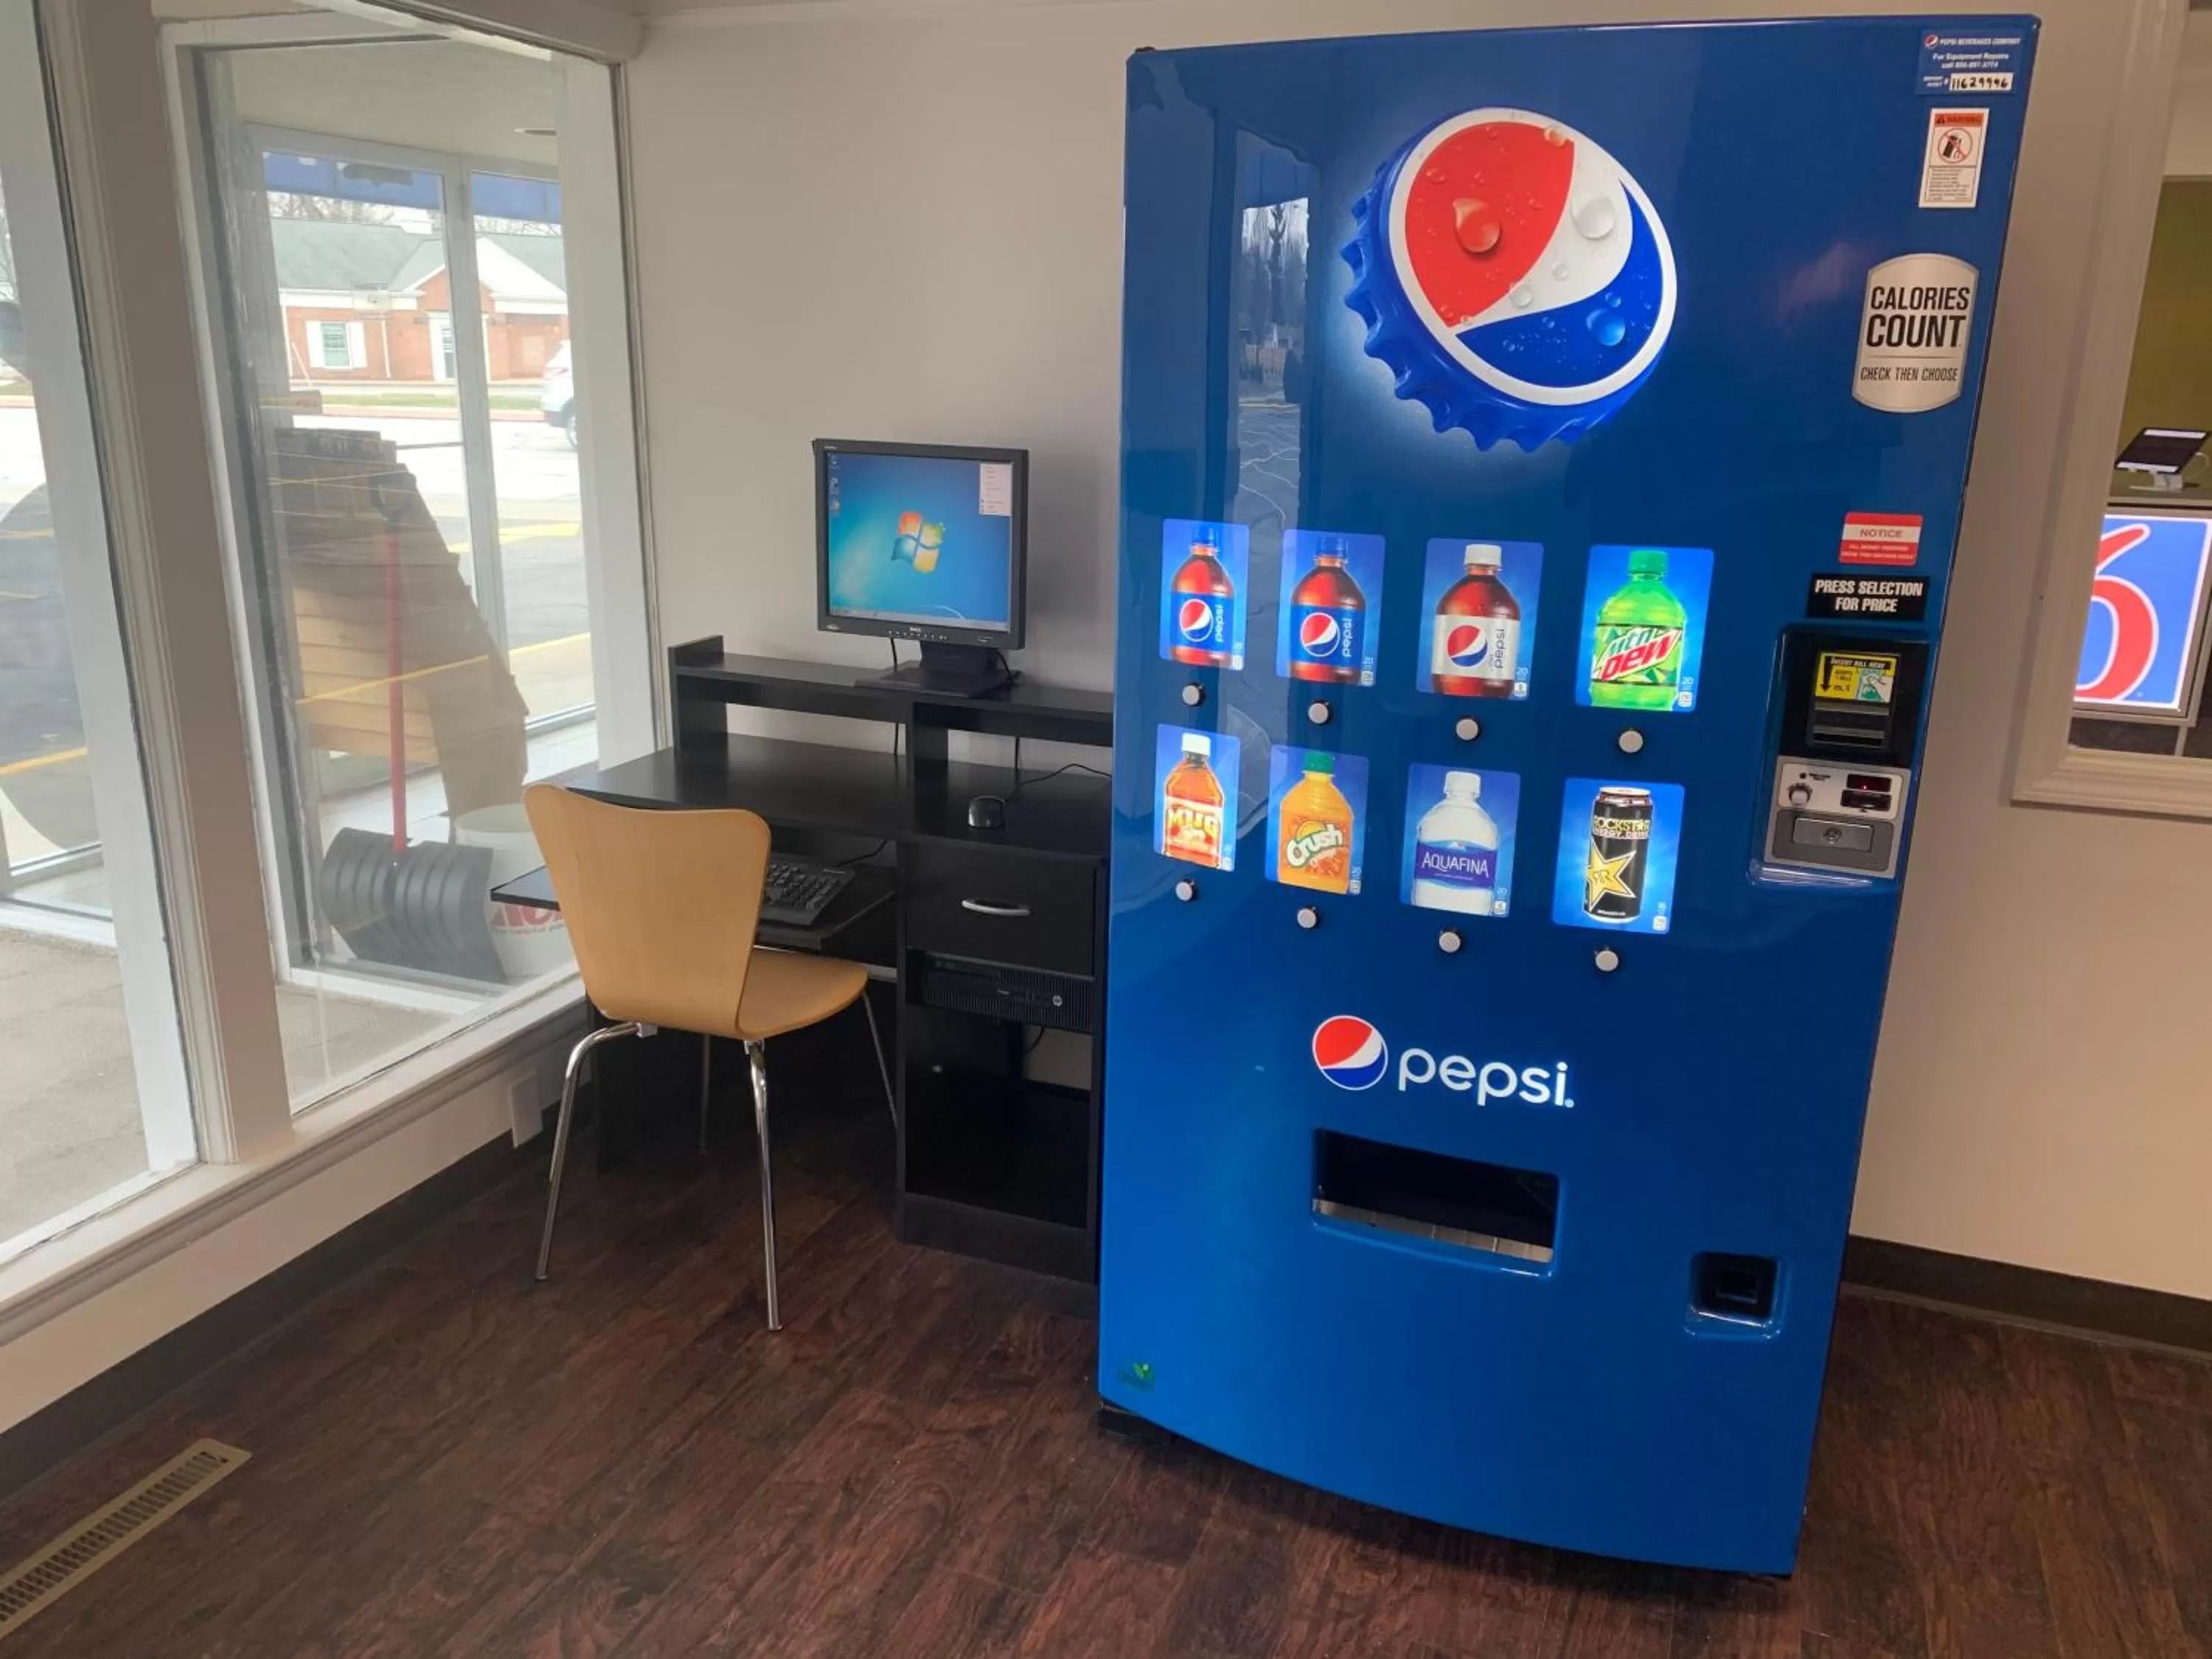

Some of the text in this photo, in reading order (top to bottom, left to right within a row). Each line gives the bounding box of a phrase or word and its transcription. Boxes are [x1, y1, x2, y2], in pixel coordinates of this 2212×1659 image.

[1871, 286, 1971, 310] CALORIES
[1865, 314, 1966, 348] COUNT
[1860, 366, 1959, 382] CHECK THEN CHOOSE
[1860, 528, 1903, 539] NOTICE
[1815, 579, 1924, 597] PRESS SELECTION
[1834, 597, 1899, 613] FOR PRICE
[1214, 603, 1225, 644] pepsi
[1342, 617, 1352, 658] pepsi
[1495, 627, 1506, 669] pepsi
[1286, 823, 1344, 867] Crush
[1421, 852, 1489, 878] AQUAFINA
